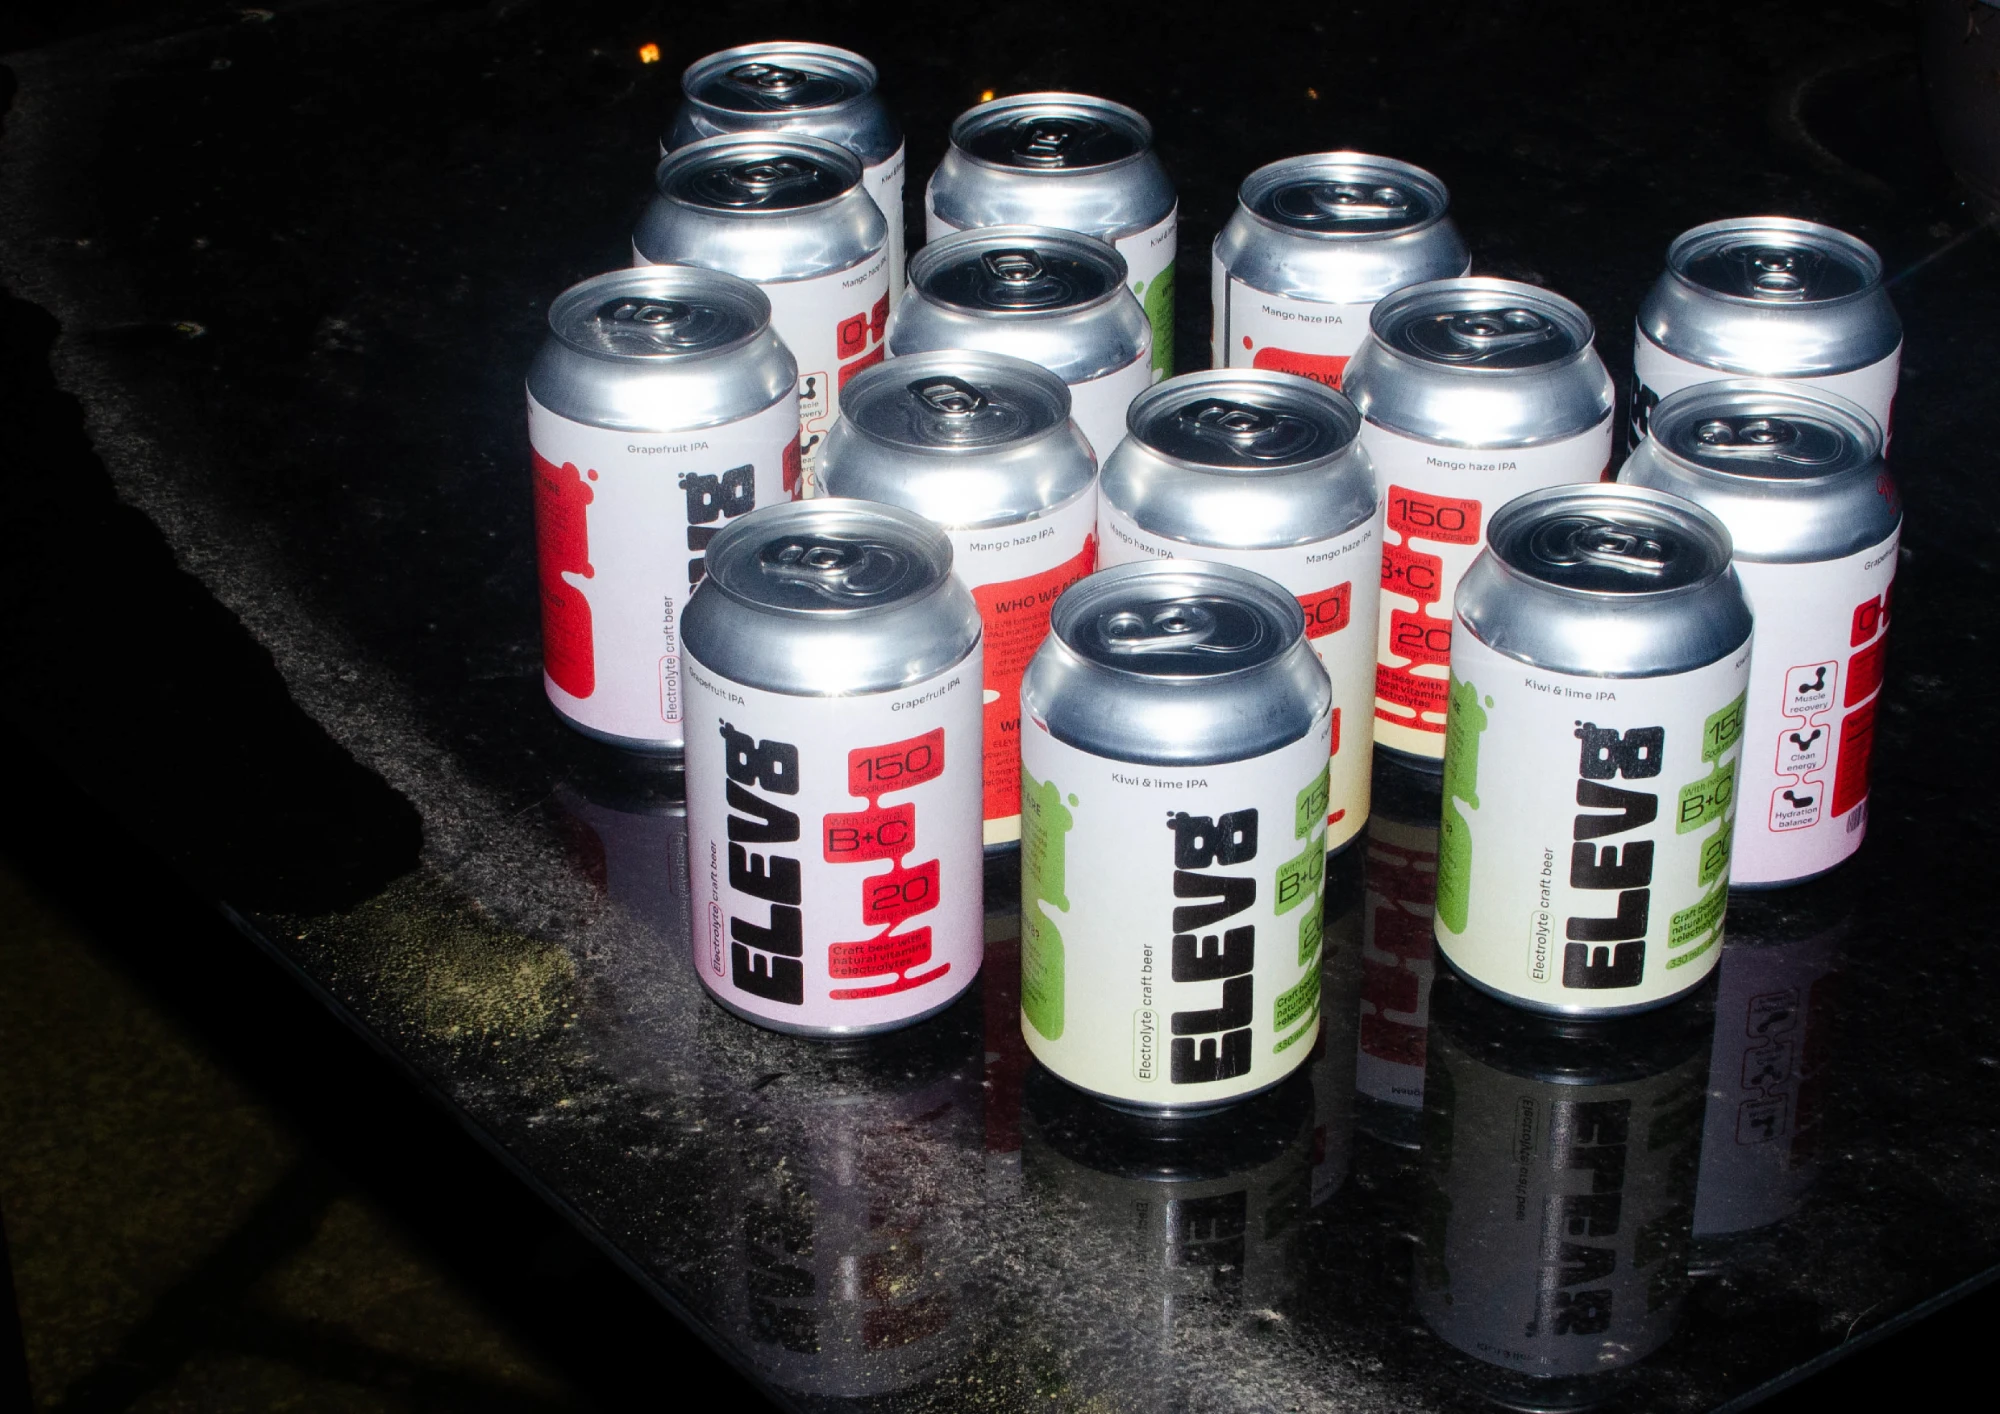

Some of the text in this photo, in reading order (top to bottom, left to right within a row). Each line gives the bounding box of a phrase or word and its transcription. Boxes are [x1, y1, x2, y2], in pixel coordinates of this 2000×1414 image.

[1262, 305, 1343, 325] Mango haze IPA
[800, 401, 819, 409] scle
[800, 410, 822, 418] overy
[627, 441, 709, 456] Grapefruit IPA
[1426, 456, 1517, 472] Mango haze IPA
[1394, 498, 1466, 532] 150
[970, 527, 1055, 552] Mango haze IPA
[1110, 522, 1174, 560] Mango haze IPA
[1306, 549, 1341, 565] Mango
[1342, 540, 1361, 555] haze
[1380, 555, 1435, 590] B+C
[995, 585, 1058, 614] WHO WE
[1302, 597, 1341, 626] 50
[1397, 622, 1451, 652] 20
[663, 595, 679, 720] Electrolyte craft beer
[689, 666, 745, 706] Grapefruit IPA
[891, 677, 961, 712] Grapefruit IPA
[1391, 671, 1415, 686] beer
[1417, 680, 1443, 692] with
[1400, 685, 1449, 701] vitamins
[1524, 678, 1617, 701] Kiwi & lime IPA
[1789, 702, 1828, 714] recovery
[1794, 692, 1826, 703] Muscle
[1708, 700, 1746, 745] 150
[855, 744, 934, 783] 150
[1786, 762, 1817, 773] energy
[1790, 753, 1816, 763] Clean
[1111, 772, 1209, 790] Kiwi & lime IPA
[1680, 774, 1733, 824] B+C
[1774, 807, 1818, 820] Hydration
[1778, 816, 1813, 828] balance
[827, 820, 908, 852] B+C
[719, 717, 804, 1006] ELEV8
[1562, 719, 1665, 990] ELEV8
[711, 871, 719, 902] craft
[871, 875, 930, 911] 20
[1532, 847, 1555, 981] Electrolyte craft beer
[1672, 908, 1696, 925] Craft
[712, 906, 722, 972] Electrolyte
[832, 933, 922, 956] Craft beer with
[1166, 807, 1259, 1085] ELEV8
[832, 941, 929, 966] natural vitamins
[832, 957, 913, 976] +electrolytes
[1138, 944, 1153, 1080] Electrolyte craft beer
